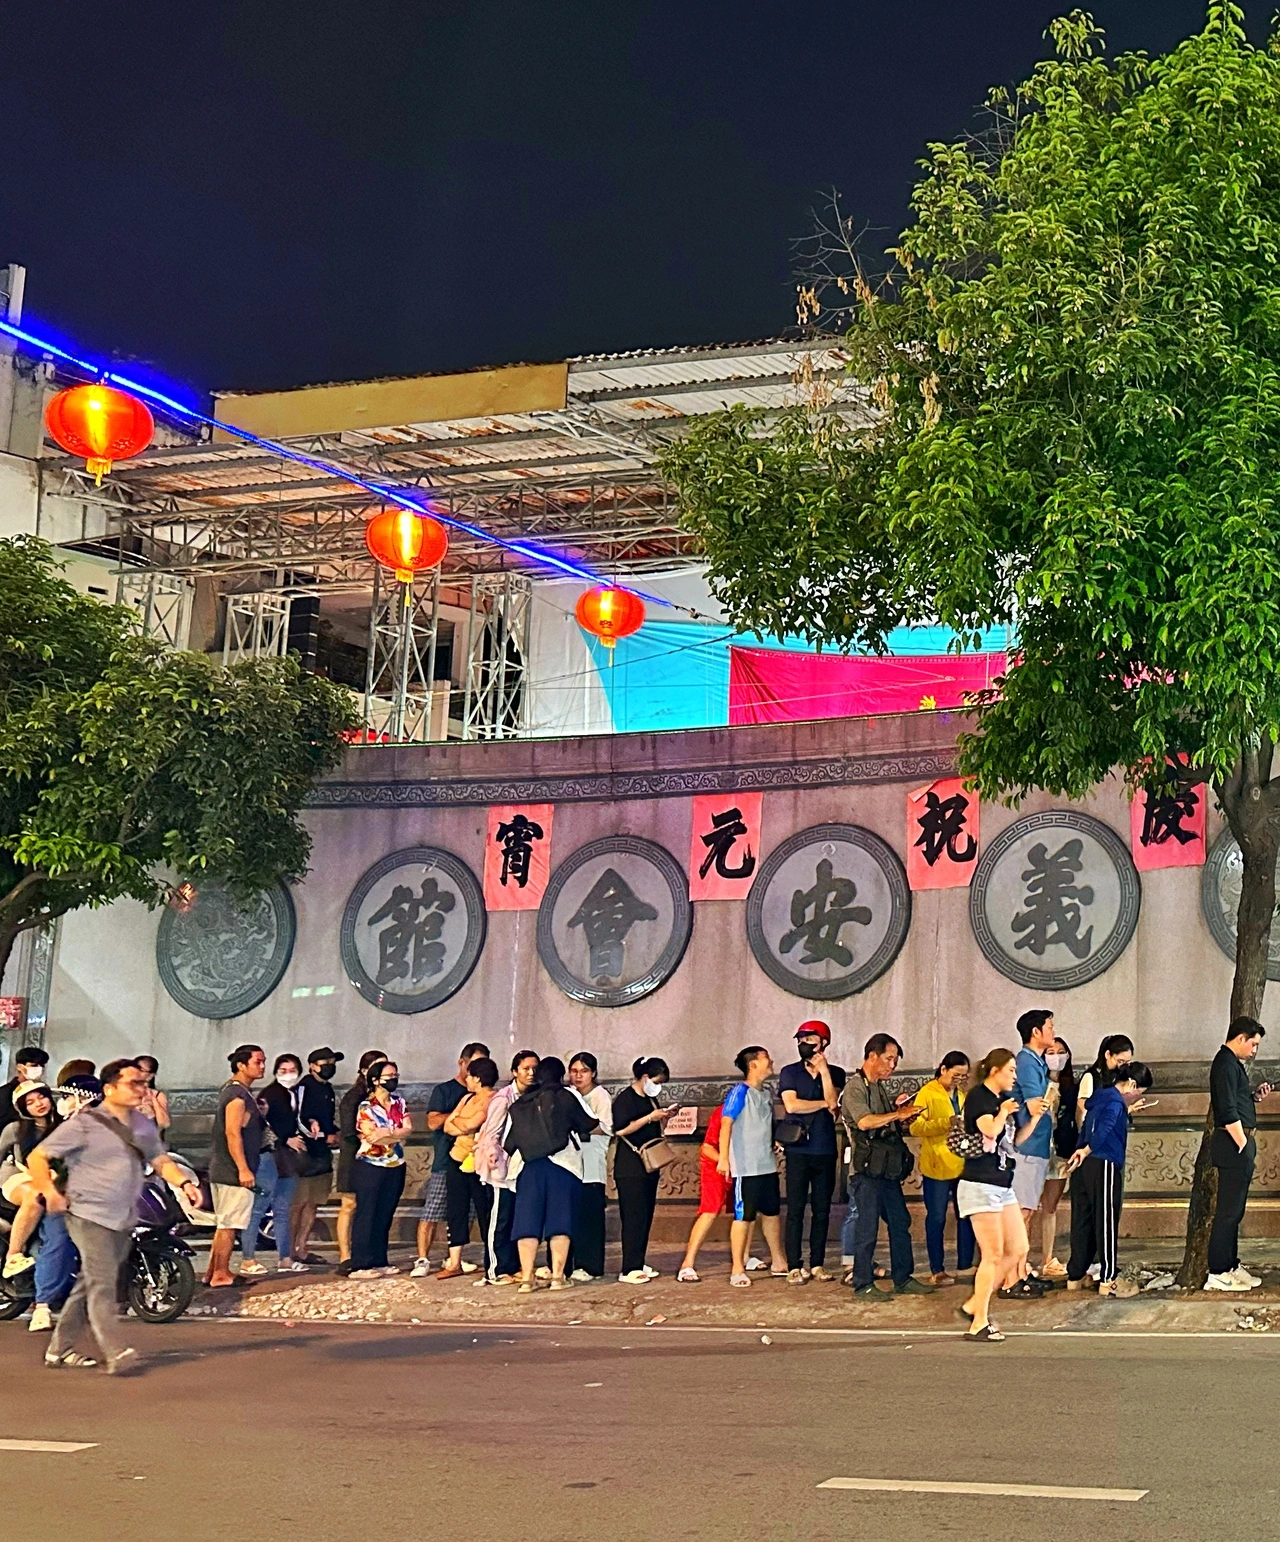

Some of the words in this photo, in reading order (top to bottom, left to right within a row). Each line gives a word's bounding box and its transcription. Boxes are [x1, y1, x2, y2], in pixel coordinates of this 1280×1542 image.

[495, 814, 545, 888] 宵
[699, 807, 757, 880] 元
[914, 791, 978, 867] 祝
[367, 877, 457, 986] 館
[567, 867, 659, 979] 會
[779, 858, 873, 967] 安
[1011, 838, 1094, 959] 義
